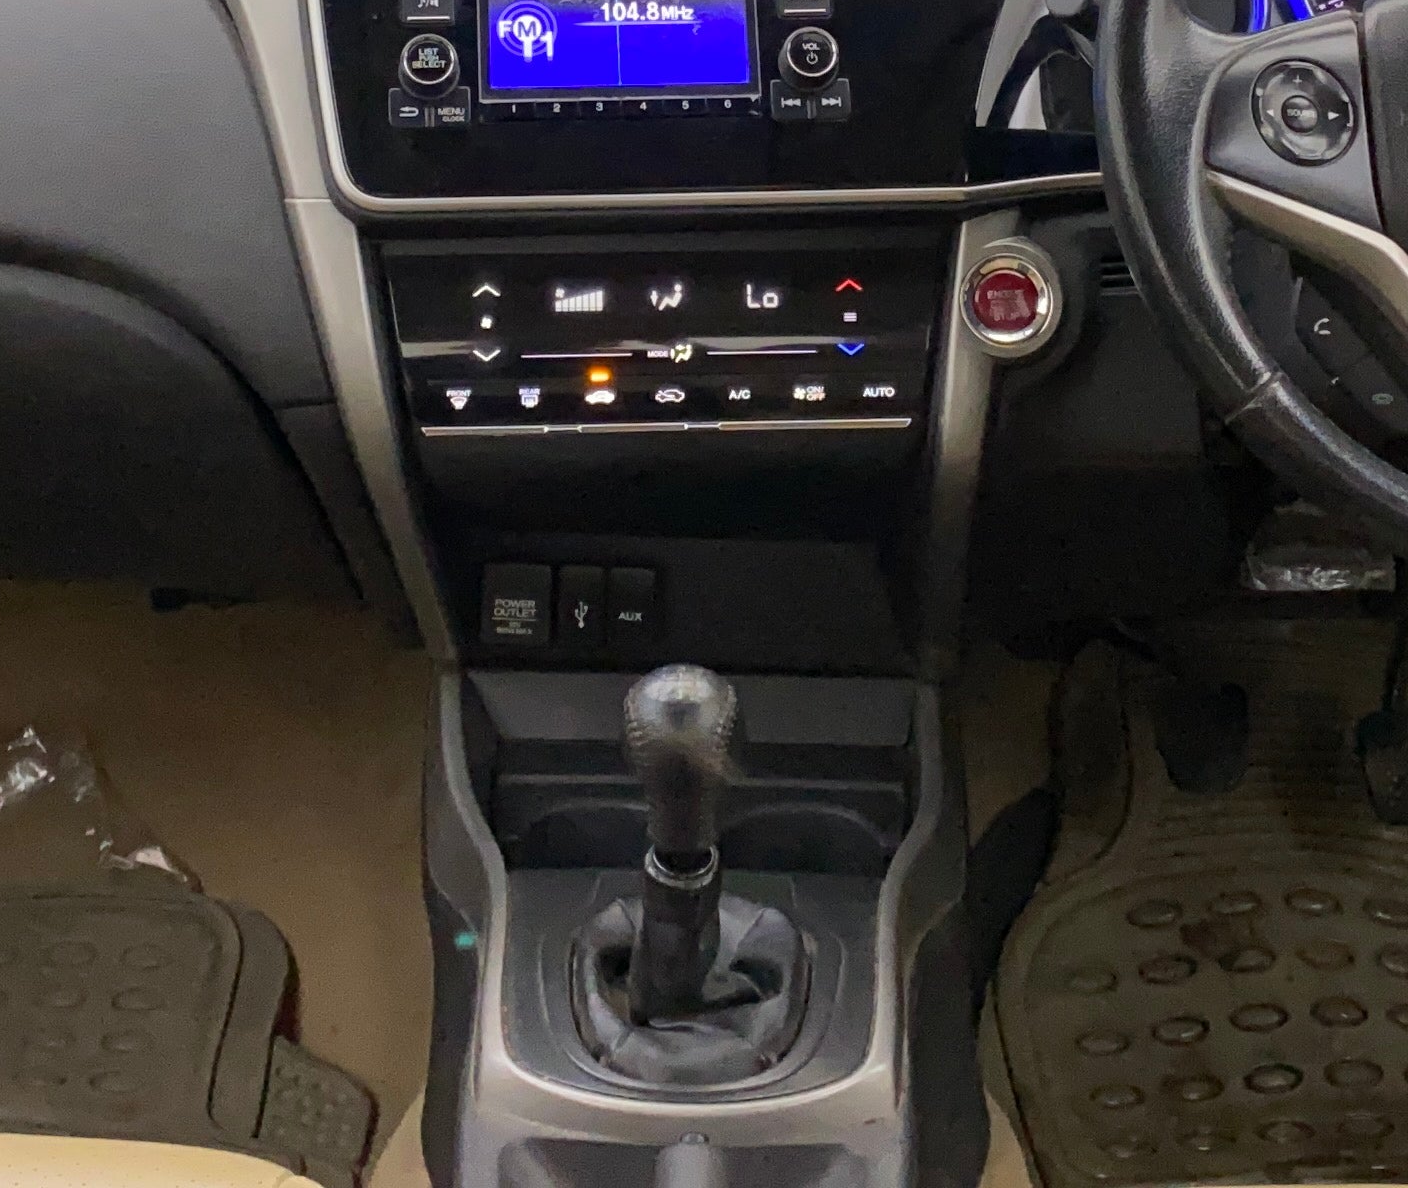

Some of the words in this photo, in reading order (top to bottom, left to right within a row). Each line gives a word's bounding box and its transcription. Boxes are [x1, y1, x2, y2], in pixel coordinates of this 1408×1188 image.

[802, 42, 820, 51] VOL
[511, 103, 517, 113] 1
[553, 103, 561, 113] 2
[595, 102, 603, 112] 3
[640, 101, 647, 111] 4
[682, 100, 690, 110] 5
[724, 99, 732, 109] 6
[437, 107, 466, 116] MENU
[446, 389, 472, 397] FRONT
[728, 389, 751, 400] A/C
[806, 393, 826, 401] OFF
[863, 386, 896, 398] AUTO
[495, 598, 536, 609] POWER
[493, 608, 537, 618] OUTLET
[618, 611, 642, 622] AUX
